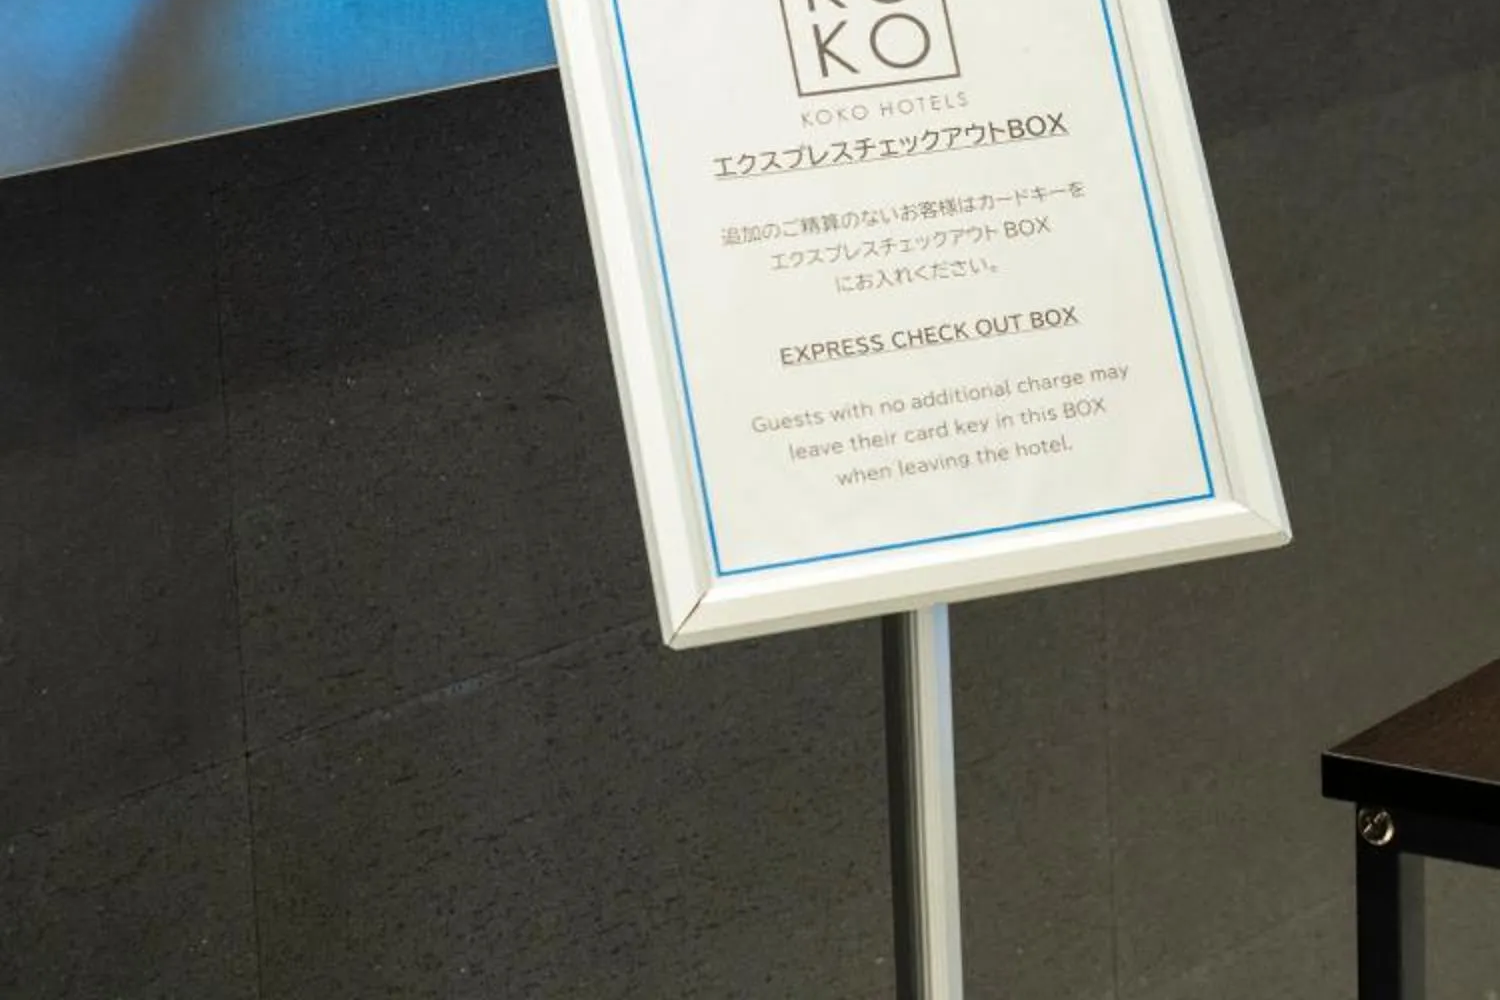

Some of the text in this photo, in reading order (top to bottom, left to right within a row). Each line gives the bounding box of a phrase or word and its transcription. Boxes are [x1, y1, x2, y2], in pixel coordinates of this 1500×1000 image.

[813, 12, 931, 78] KO
[801, 92, 969, 129] KOKO HOTELS
[1004, 216, 1052, 240] BOX
[780, 306, 1079, 366] EXPRESS CHECK OUT BOX
[751, 363, 1130, 434] Guests with no additional charge may
[788, 397, 1107, 462] leave their card key in this BOX
[837, 436, 1073, 487] when leaving the hotel.
